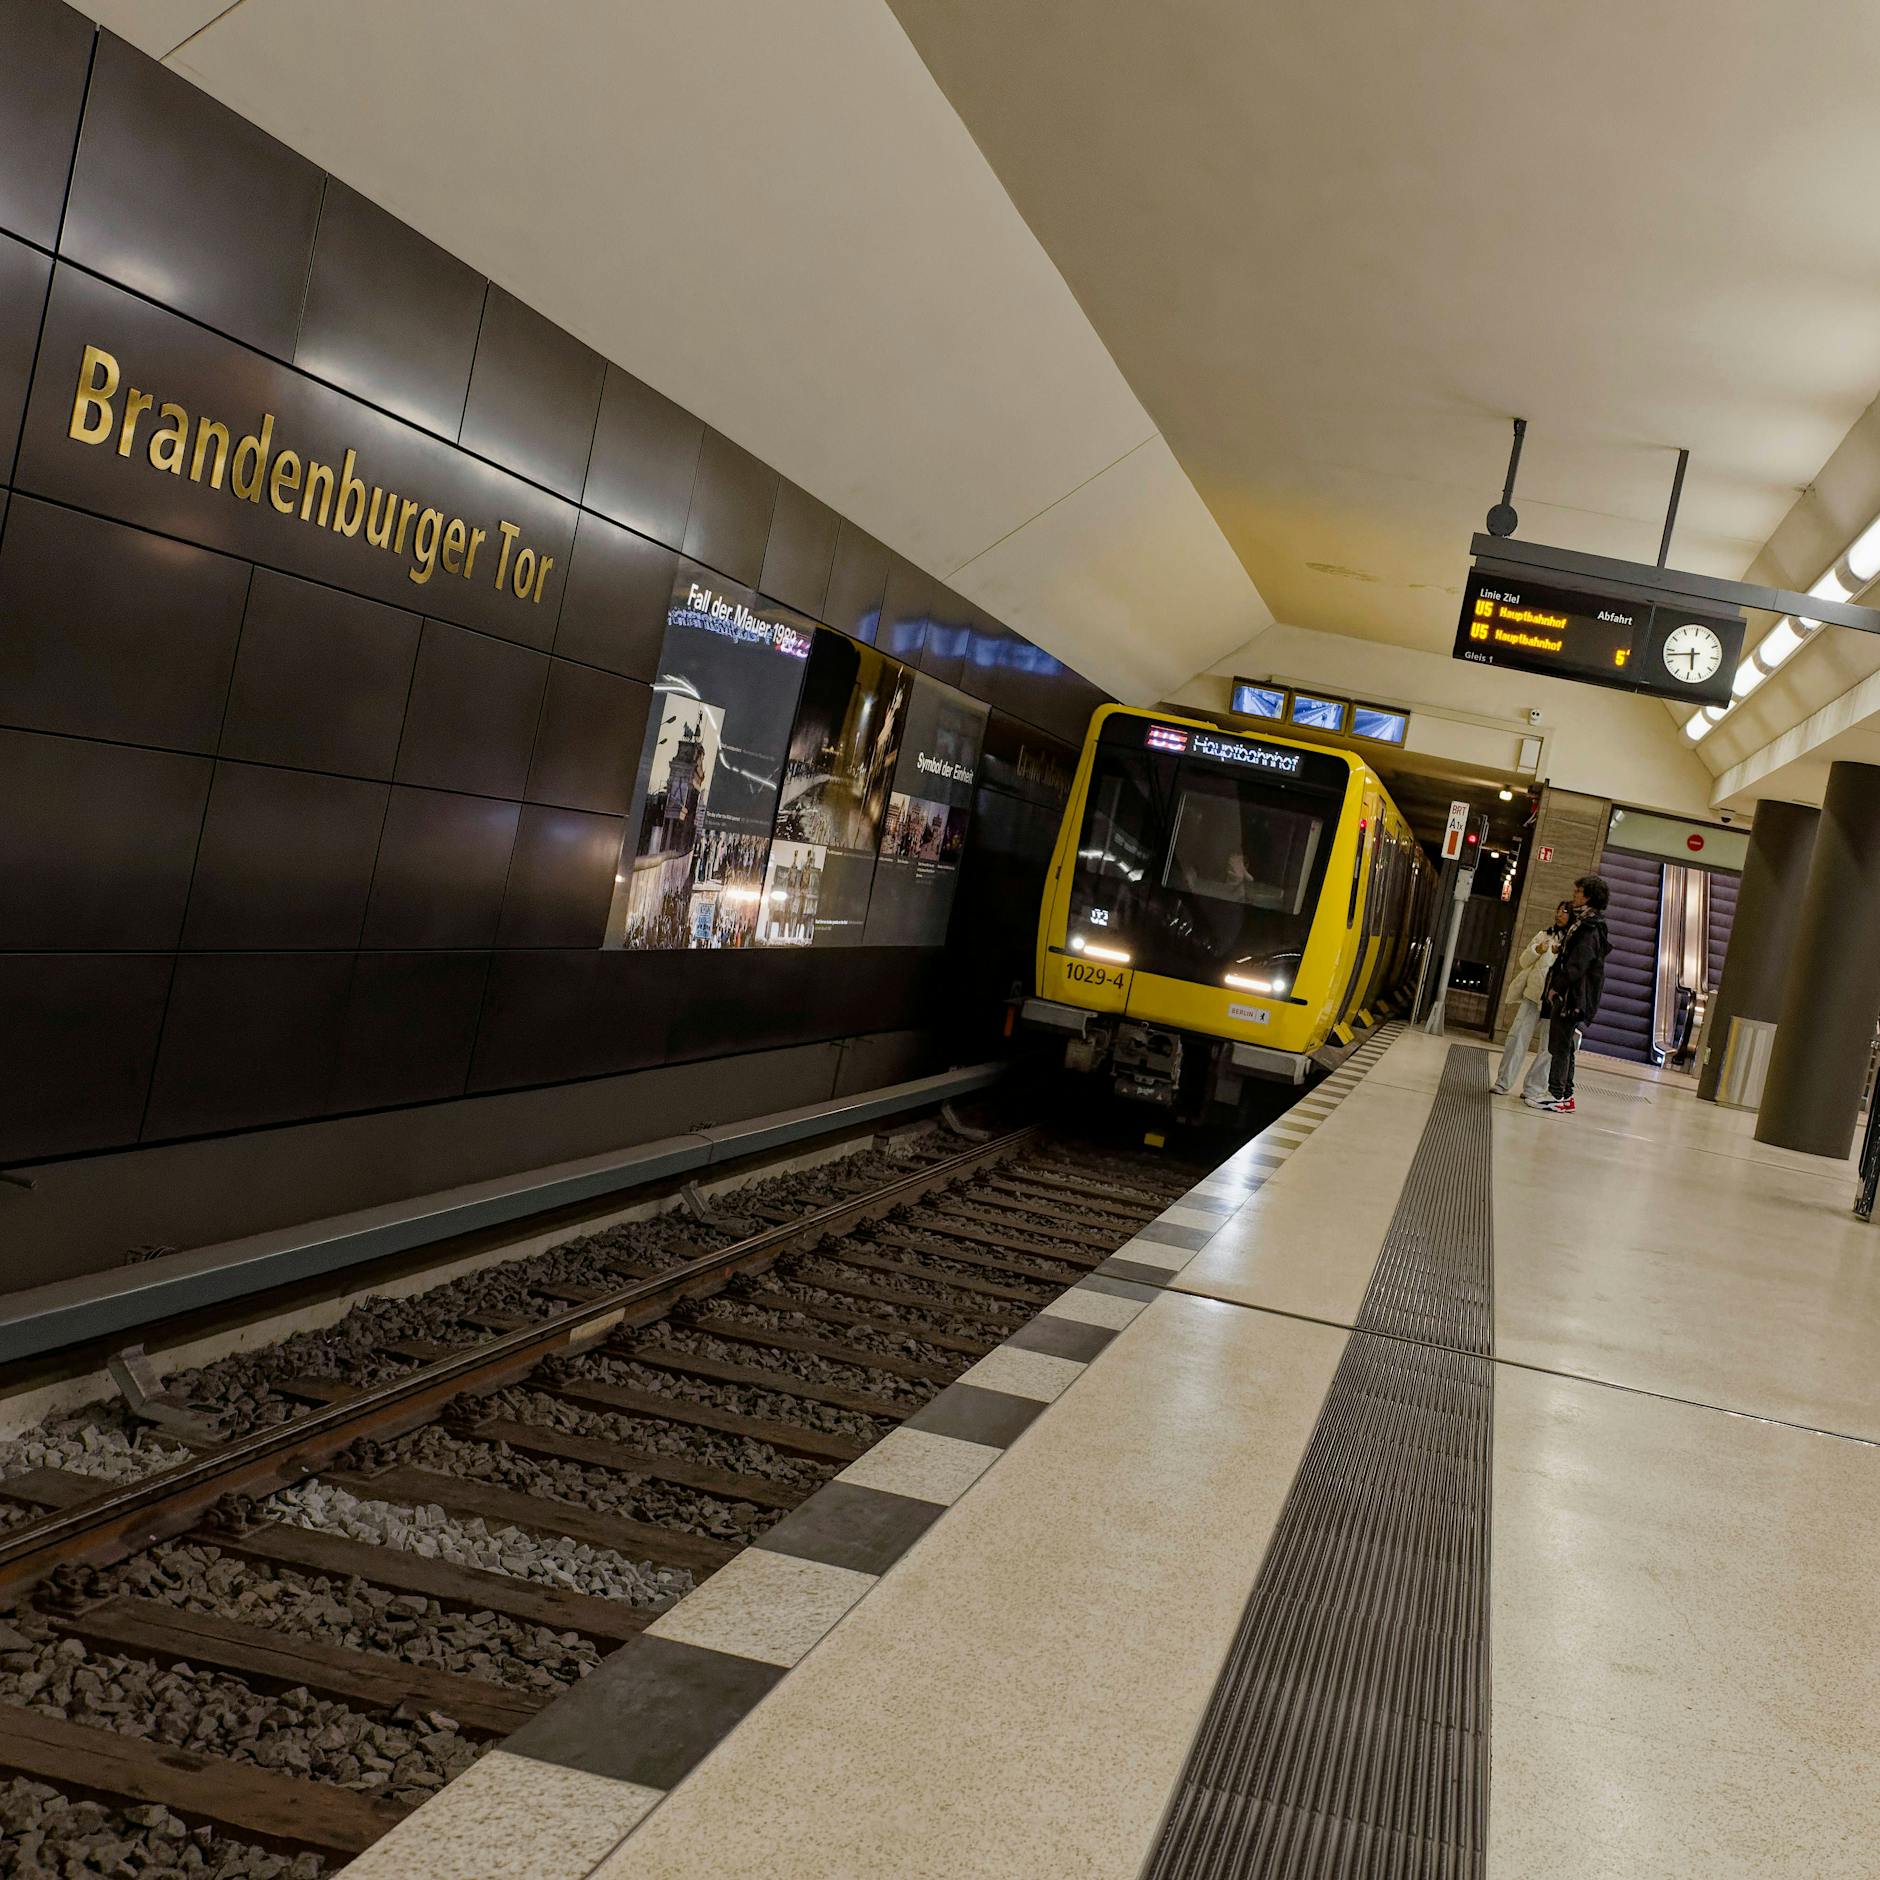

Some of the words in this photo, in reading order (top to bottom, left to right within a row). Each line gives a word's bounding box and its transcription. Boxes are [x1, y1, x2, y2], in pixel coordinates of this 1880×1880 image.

[67, 344, 487, 584] Brandenburger
[494, 519, 554, 604] Tor
[1480, 588, 1502, 601] Linie
[1502, 592, 1520, 604] Ziel
[687, 583, 712, 613] Fall
[711, 596, 733, 620] der
[734, 604, 772, 638] Mauer
[1474, 599, 1494, 616] U5
[1499, 606, 1567, 629] Hauptbahnhof
[1597, 610, 1633, 626] Abfahrt
[1470, 622, 1489, 640] U5
[1494, 628, 1562, 652] Hauptbahnhof
[1464, 651, 1487, 662] Gleis
[1193, 735, 1300, 772] Hauptbahnhof
[917, 752, 943, 773] Symbol
[941, 761, 953, 778] der
[952, 764, 974, 784] Einheit
[1452, 804, 1467, 816] BRT
[1066, 962, 1124, 989] 1029-4
[1231, 1008, 1254, 1017] BERLIN
